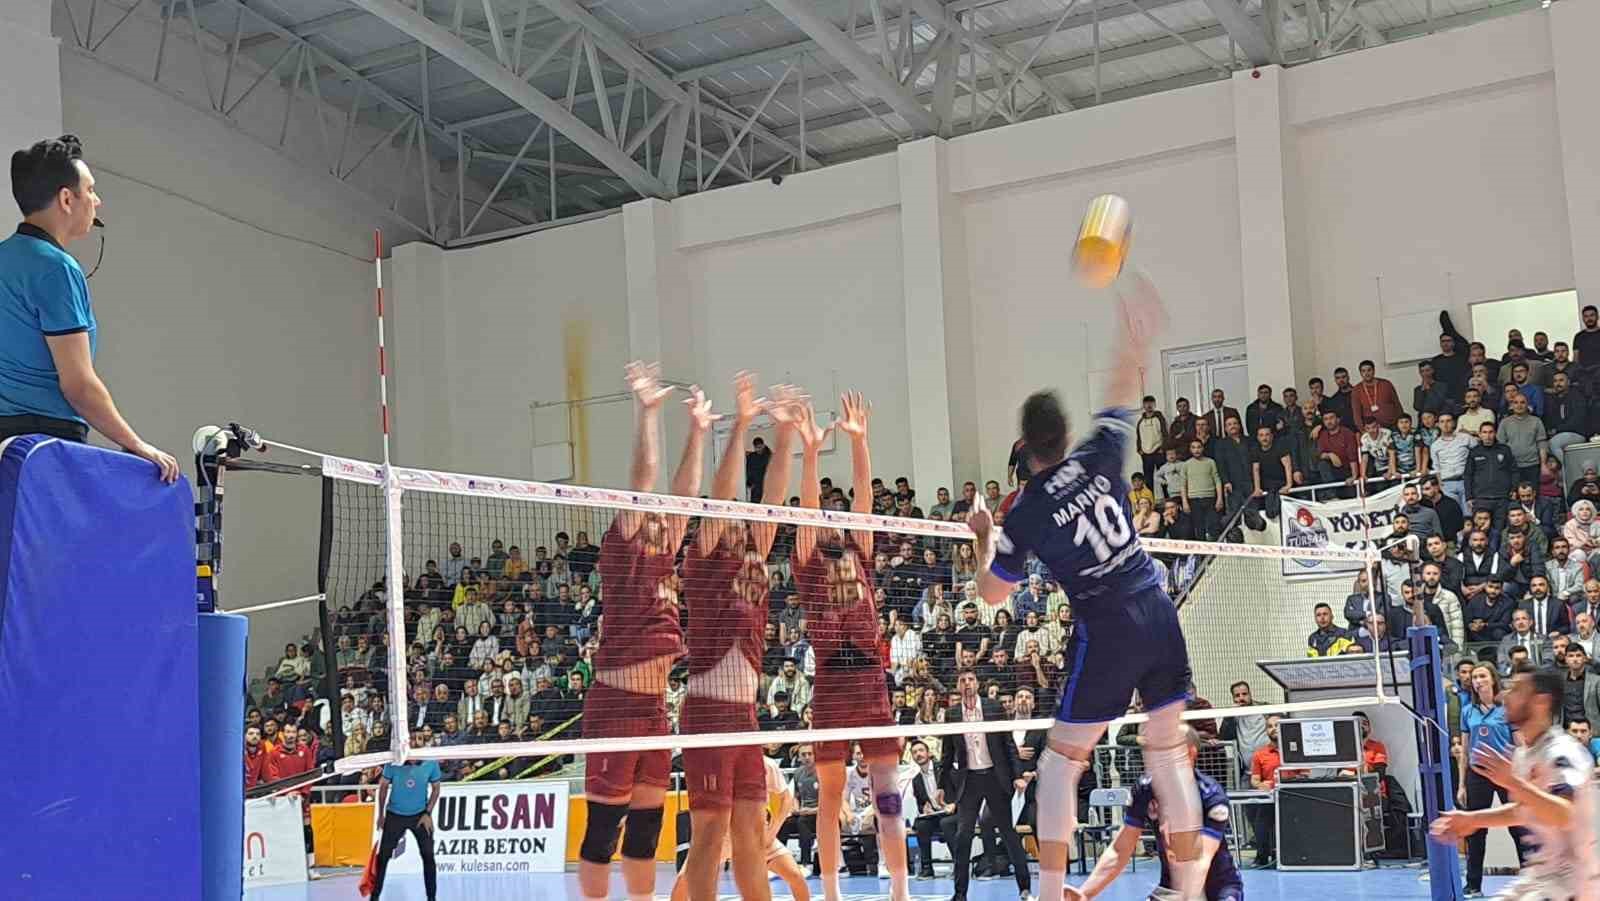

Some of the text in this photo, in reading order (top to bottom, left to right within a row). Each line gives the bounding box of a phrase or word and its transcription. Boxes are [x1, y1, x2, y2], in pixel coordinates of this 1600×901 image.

[1052, 474, 1112, 527] MARKO
[1073, 494, 1131, 563] 10
[437, 793, 556, 831] ULESAN
[434, 837, 547, 855] AZIR BETON
[460, 858, 530, 873] kulesan.com
